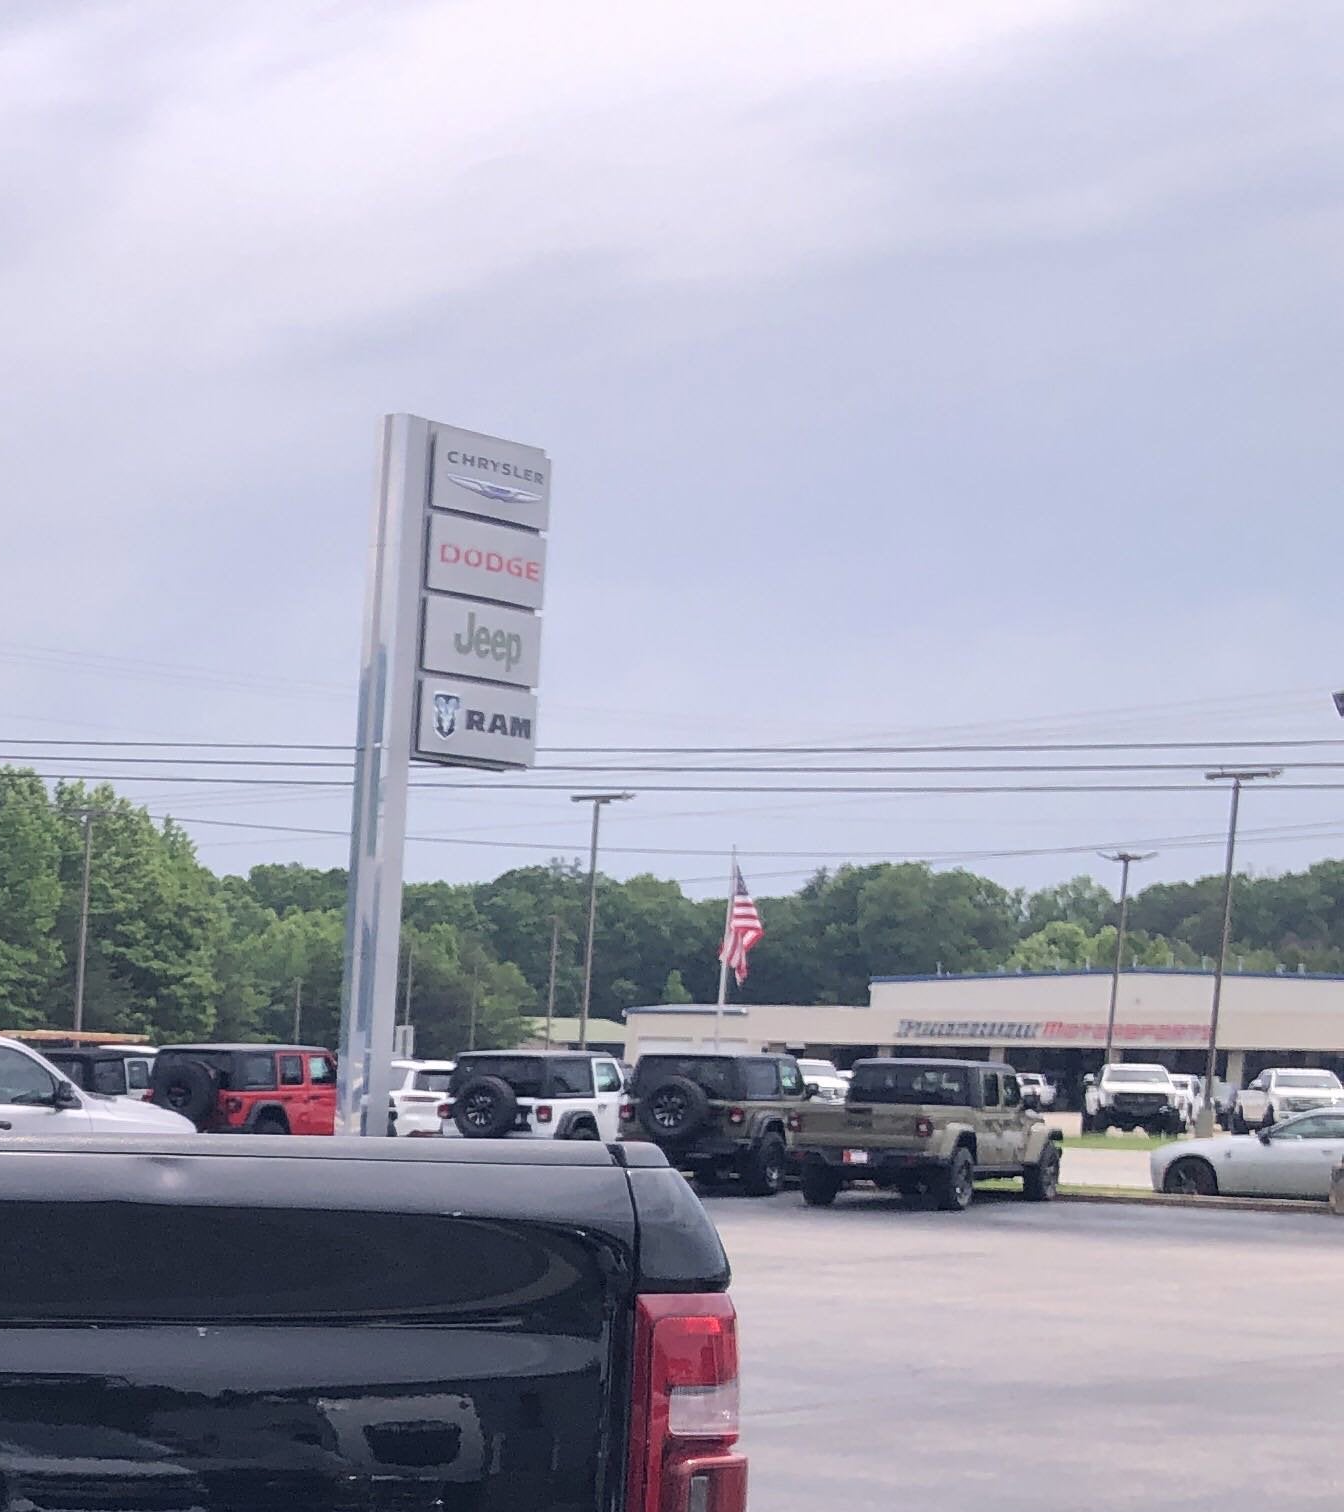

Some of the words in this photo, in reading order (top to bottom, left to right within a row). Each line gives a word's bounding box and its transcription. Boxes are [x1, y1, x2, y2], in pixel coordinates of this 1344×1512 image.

[447, 450, 544, 485] CHRYSLER
[439, 543, 541, 583] DODGE
[454, 611, 523, 672] Jeep
[465, 709, 532, 739] RAM
